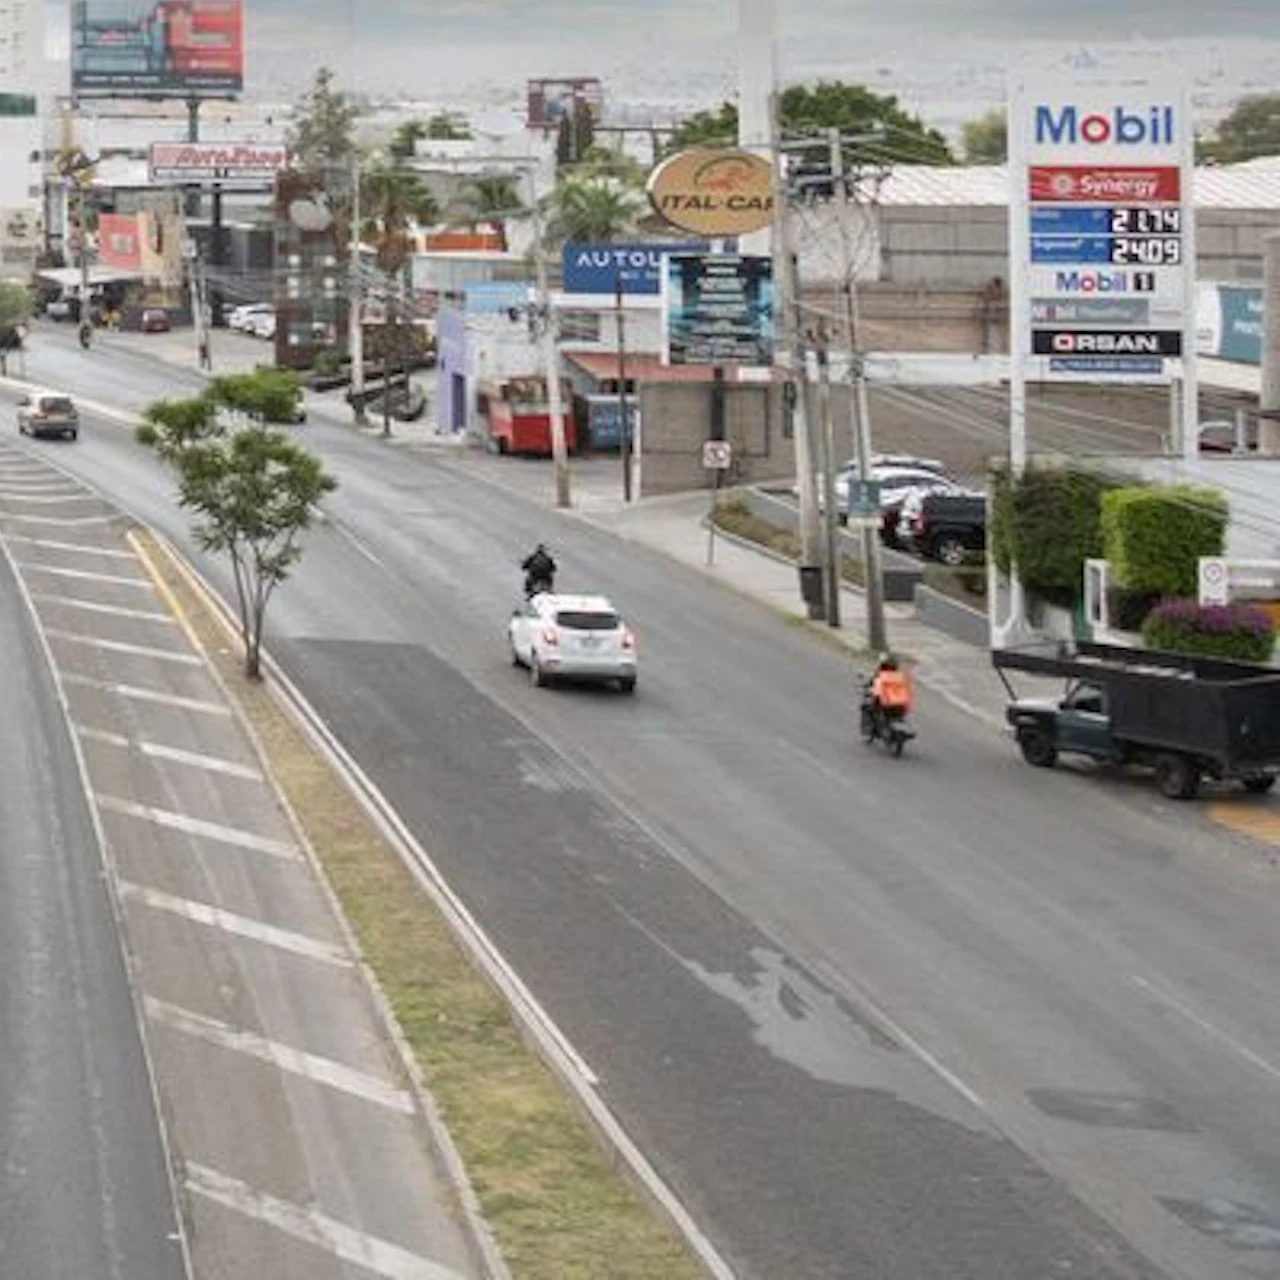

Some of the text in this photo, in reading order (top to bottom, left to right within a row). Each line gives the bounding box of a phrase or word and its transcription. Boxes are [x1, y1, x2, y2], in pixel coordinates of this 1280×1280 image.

[1036, 105, 1172, 144] Mobil
[1079, 175, 1159, 197] Synergy
[577, 251, 660, 267] AUTOL
[1056, 271, 1126, 292] Mobil
[1053, 333, 1158, 351] ORSAN
